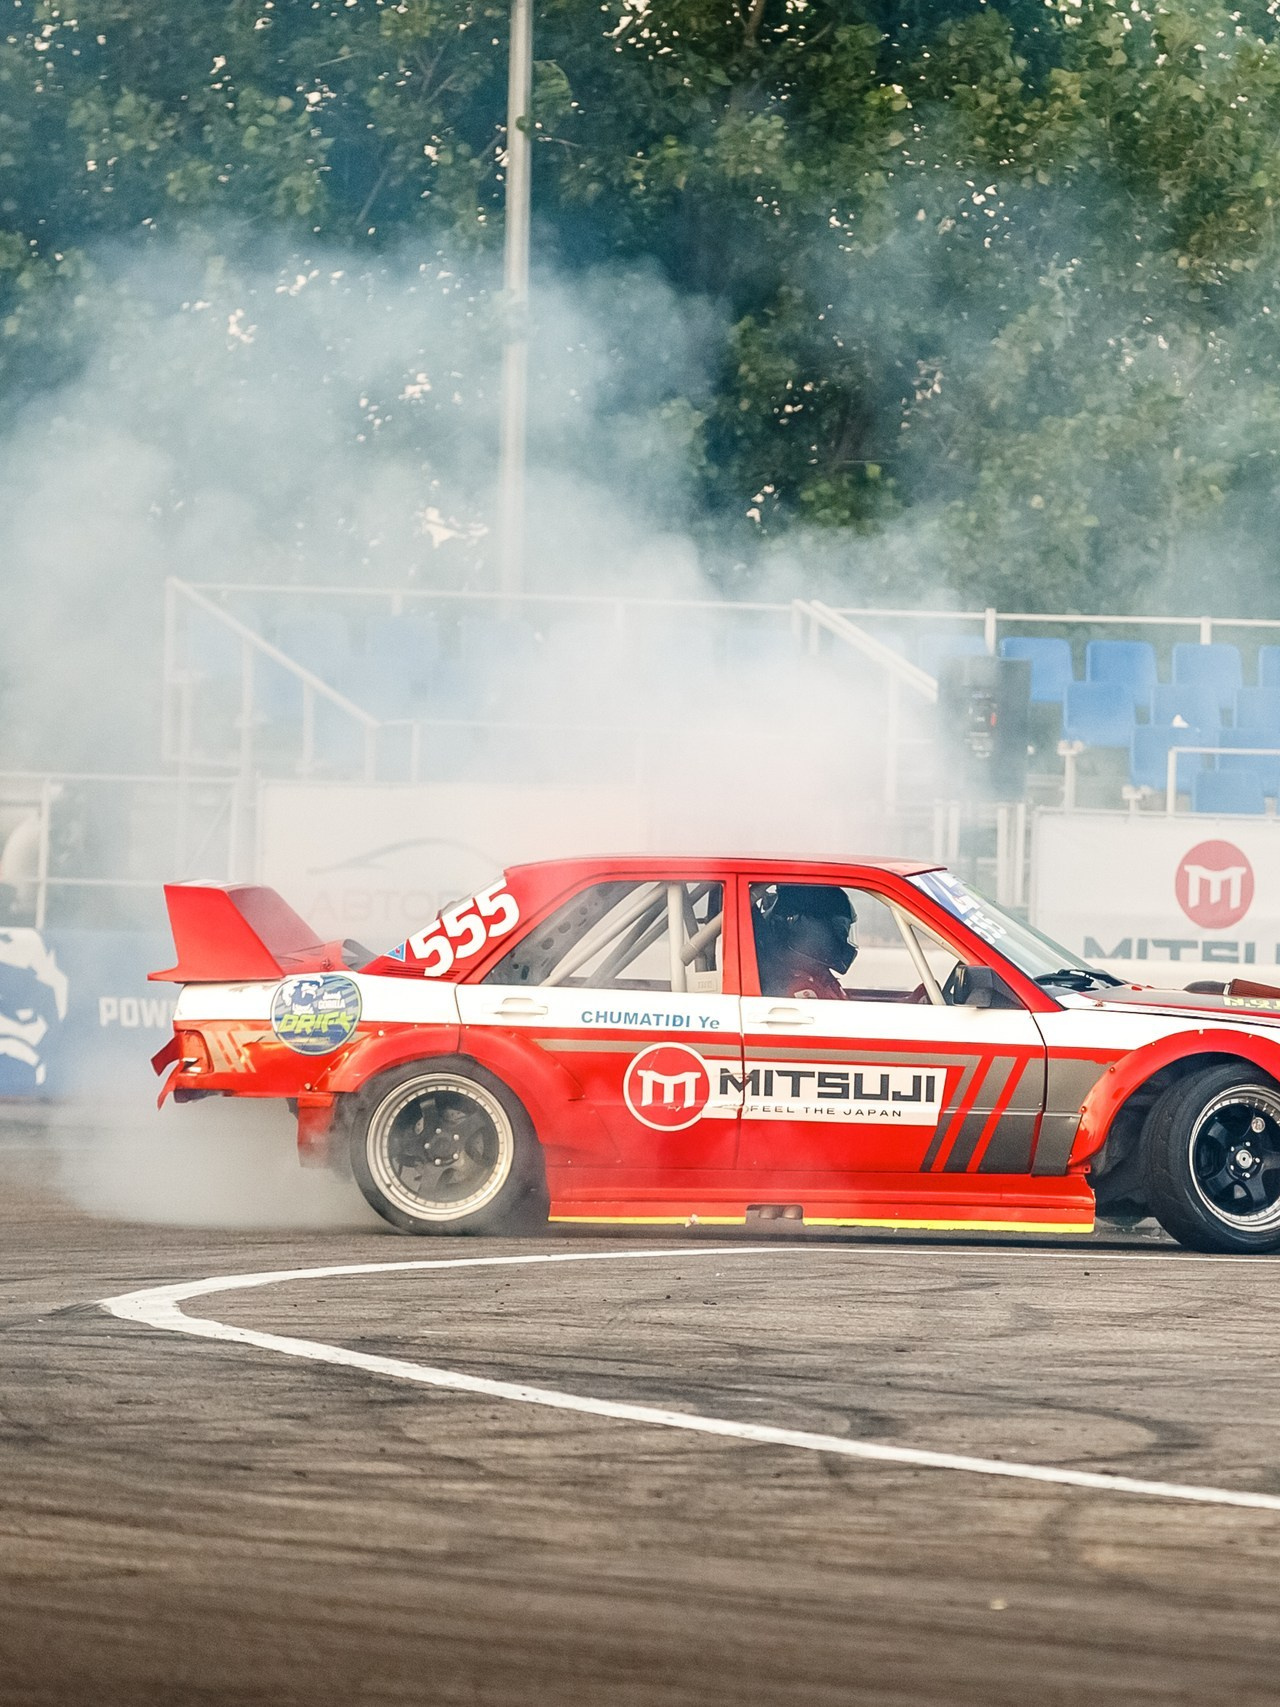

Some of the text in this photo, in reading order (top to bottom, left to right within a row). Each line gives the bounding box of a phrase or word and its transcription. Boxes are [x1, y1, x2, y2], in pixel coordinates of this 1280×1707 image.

[408, 878, 520, 977] 555
[98, 995, 177, 1028] POW
[581, 1011, 720, 1030] CHUMATIDI Ye
[719, 1068, 936, 1103] MITSUJI
[750, 1105, 902, 1118] FEEL THE JAPAN
